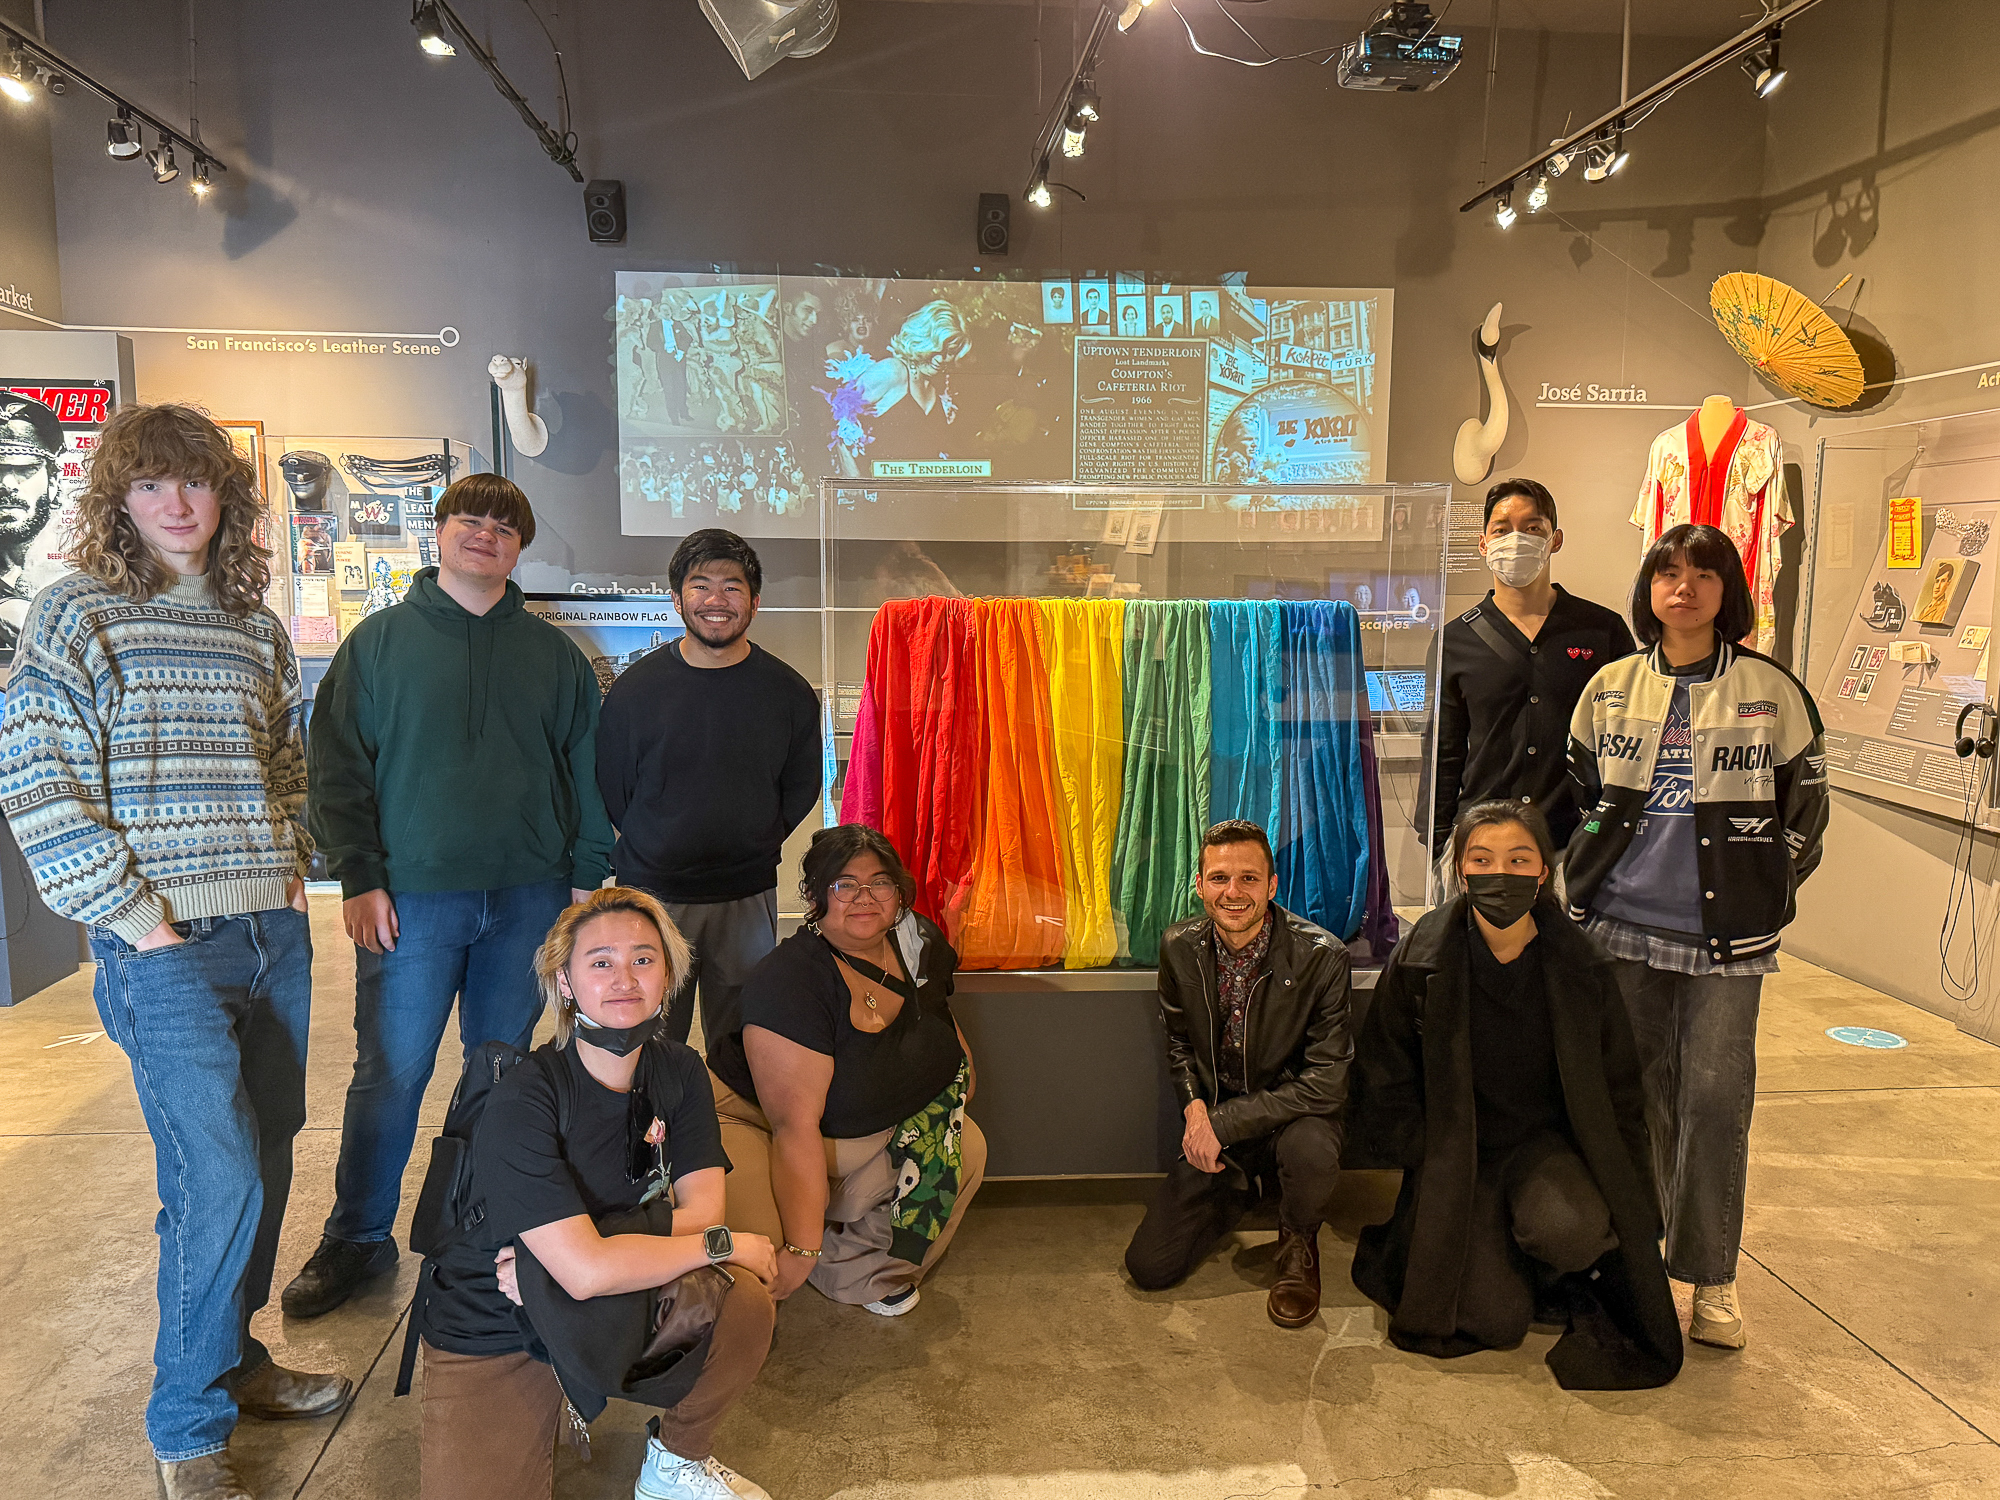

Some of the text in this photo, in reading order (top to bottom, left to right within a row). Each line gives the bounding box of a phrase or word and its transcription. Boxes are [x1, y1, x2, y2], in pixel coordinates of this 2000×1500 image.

[186, 335, 219, 350] San
[322, 339, 387, 354] Leather
[392, 340, 441, 355] Scene
[1083, 346, 1201, 357] UPTOWN TENDERLOIN
[1337, 356, 1373, 369] TURK
[1097, 381, 1186, 392] CAFETERIA RIOT
[1537, 382, 1648, 402] José Sarria
[1131, 396, 1152, 404] 1966
[880, 463, 983, 475] THE TENDERLOIN
[404, 486, 422, 496] THE
[407, 520, 436, 530] MEN
[536, 611, 587, 621] ORIGINAL
[589, 613, 639, 621] RAINBOW
[641, 613, 668, 621] FLAG
[1739, 704, 1777, 714] RACING
[1657, 748, 1693, 760] ATI
